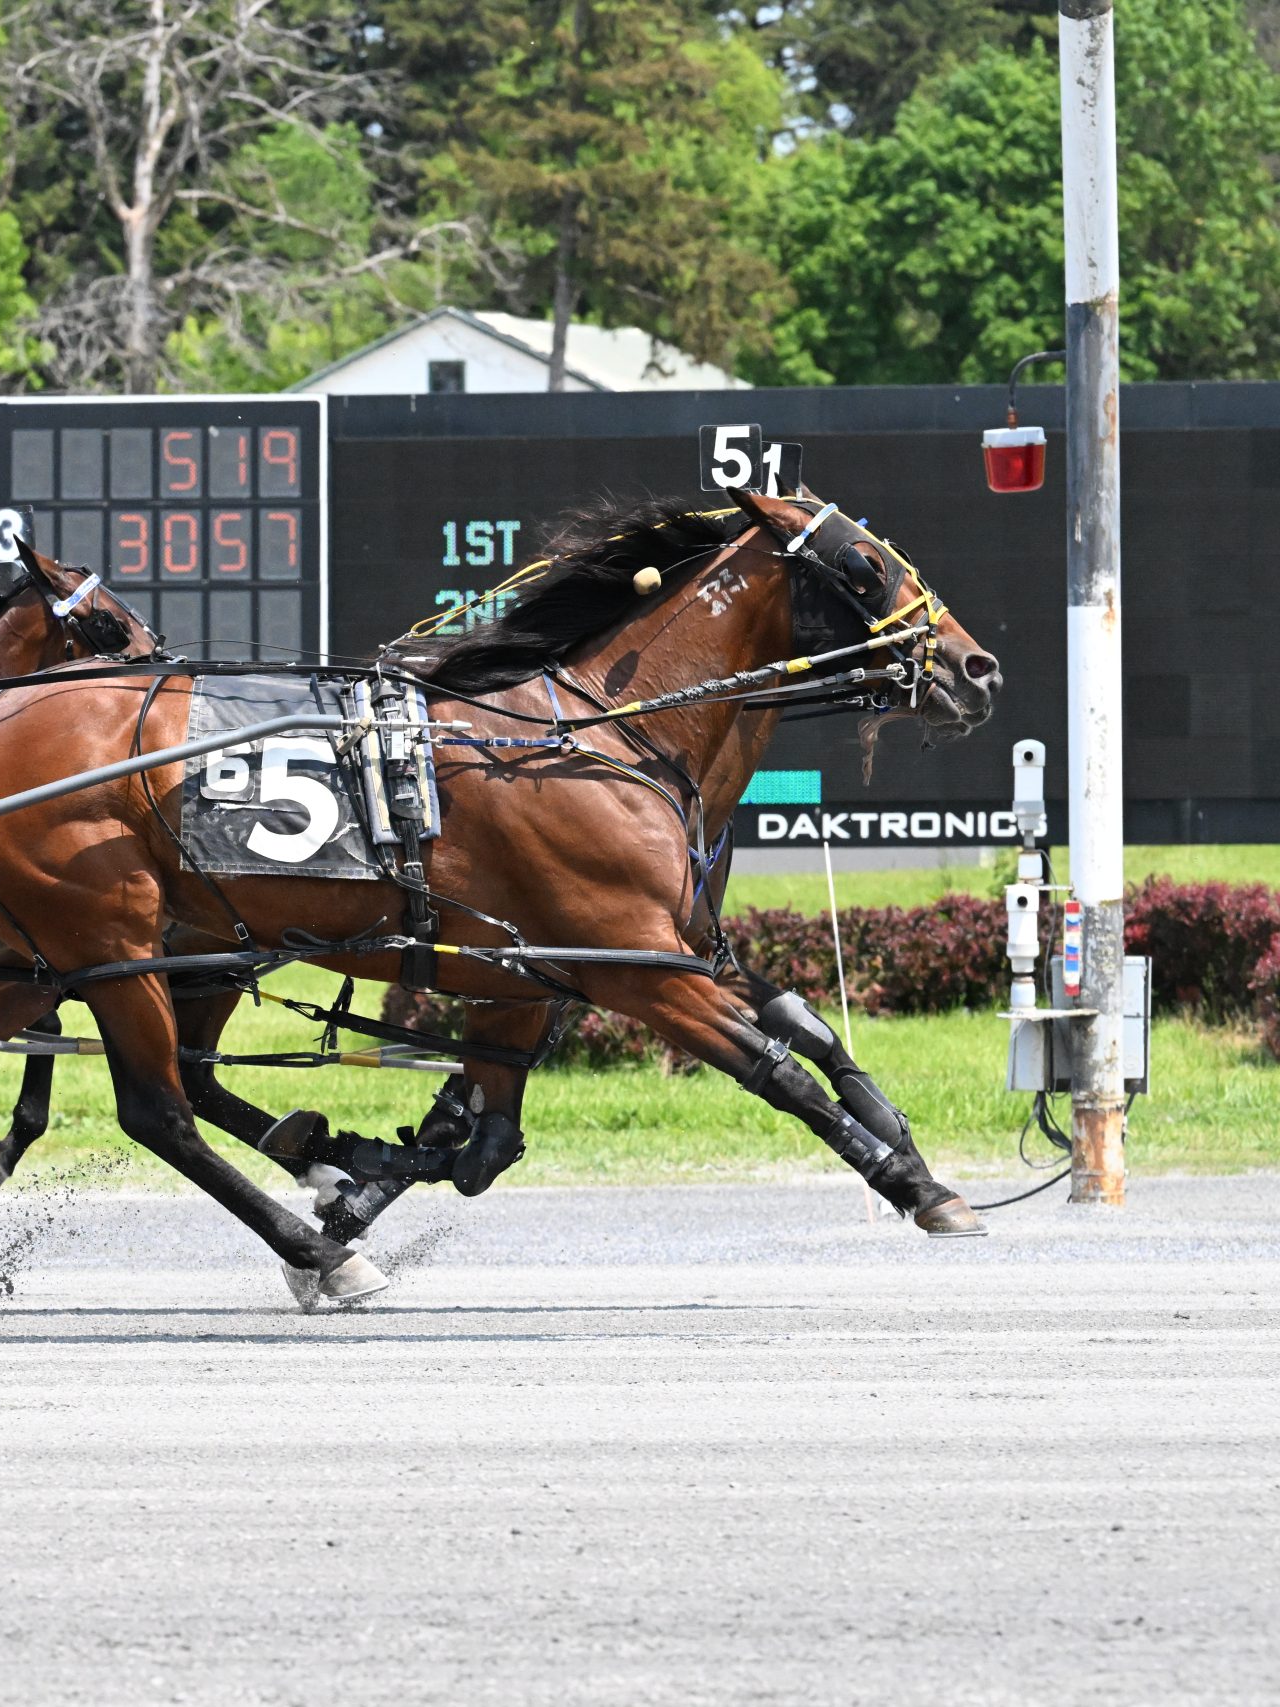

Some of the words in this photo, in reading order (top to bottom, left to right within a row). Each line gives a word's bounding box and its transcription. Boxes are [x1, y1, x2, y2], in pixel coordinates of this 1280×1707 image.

[163, 432, 297, 491] 519
[711, 425, 752, 489] 5
[762, 443, 782, 499] 1
[119, 513, 298, 573] 3057
[442, 521, 521, 566] 1ST
[206, 740, 251, 793] 6
[246, 737, 339, 863] 5
